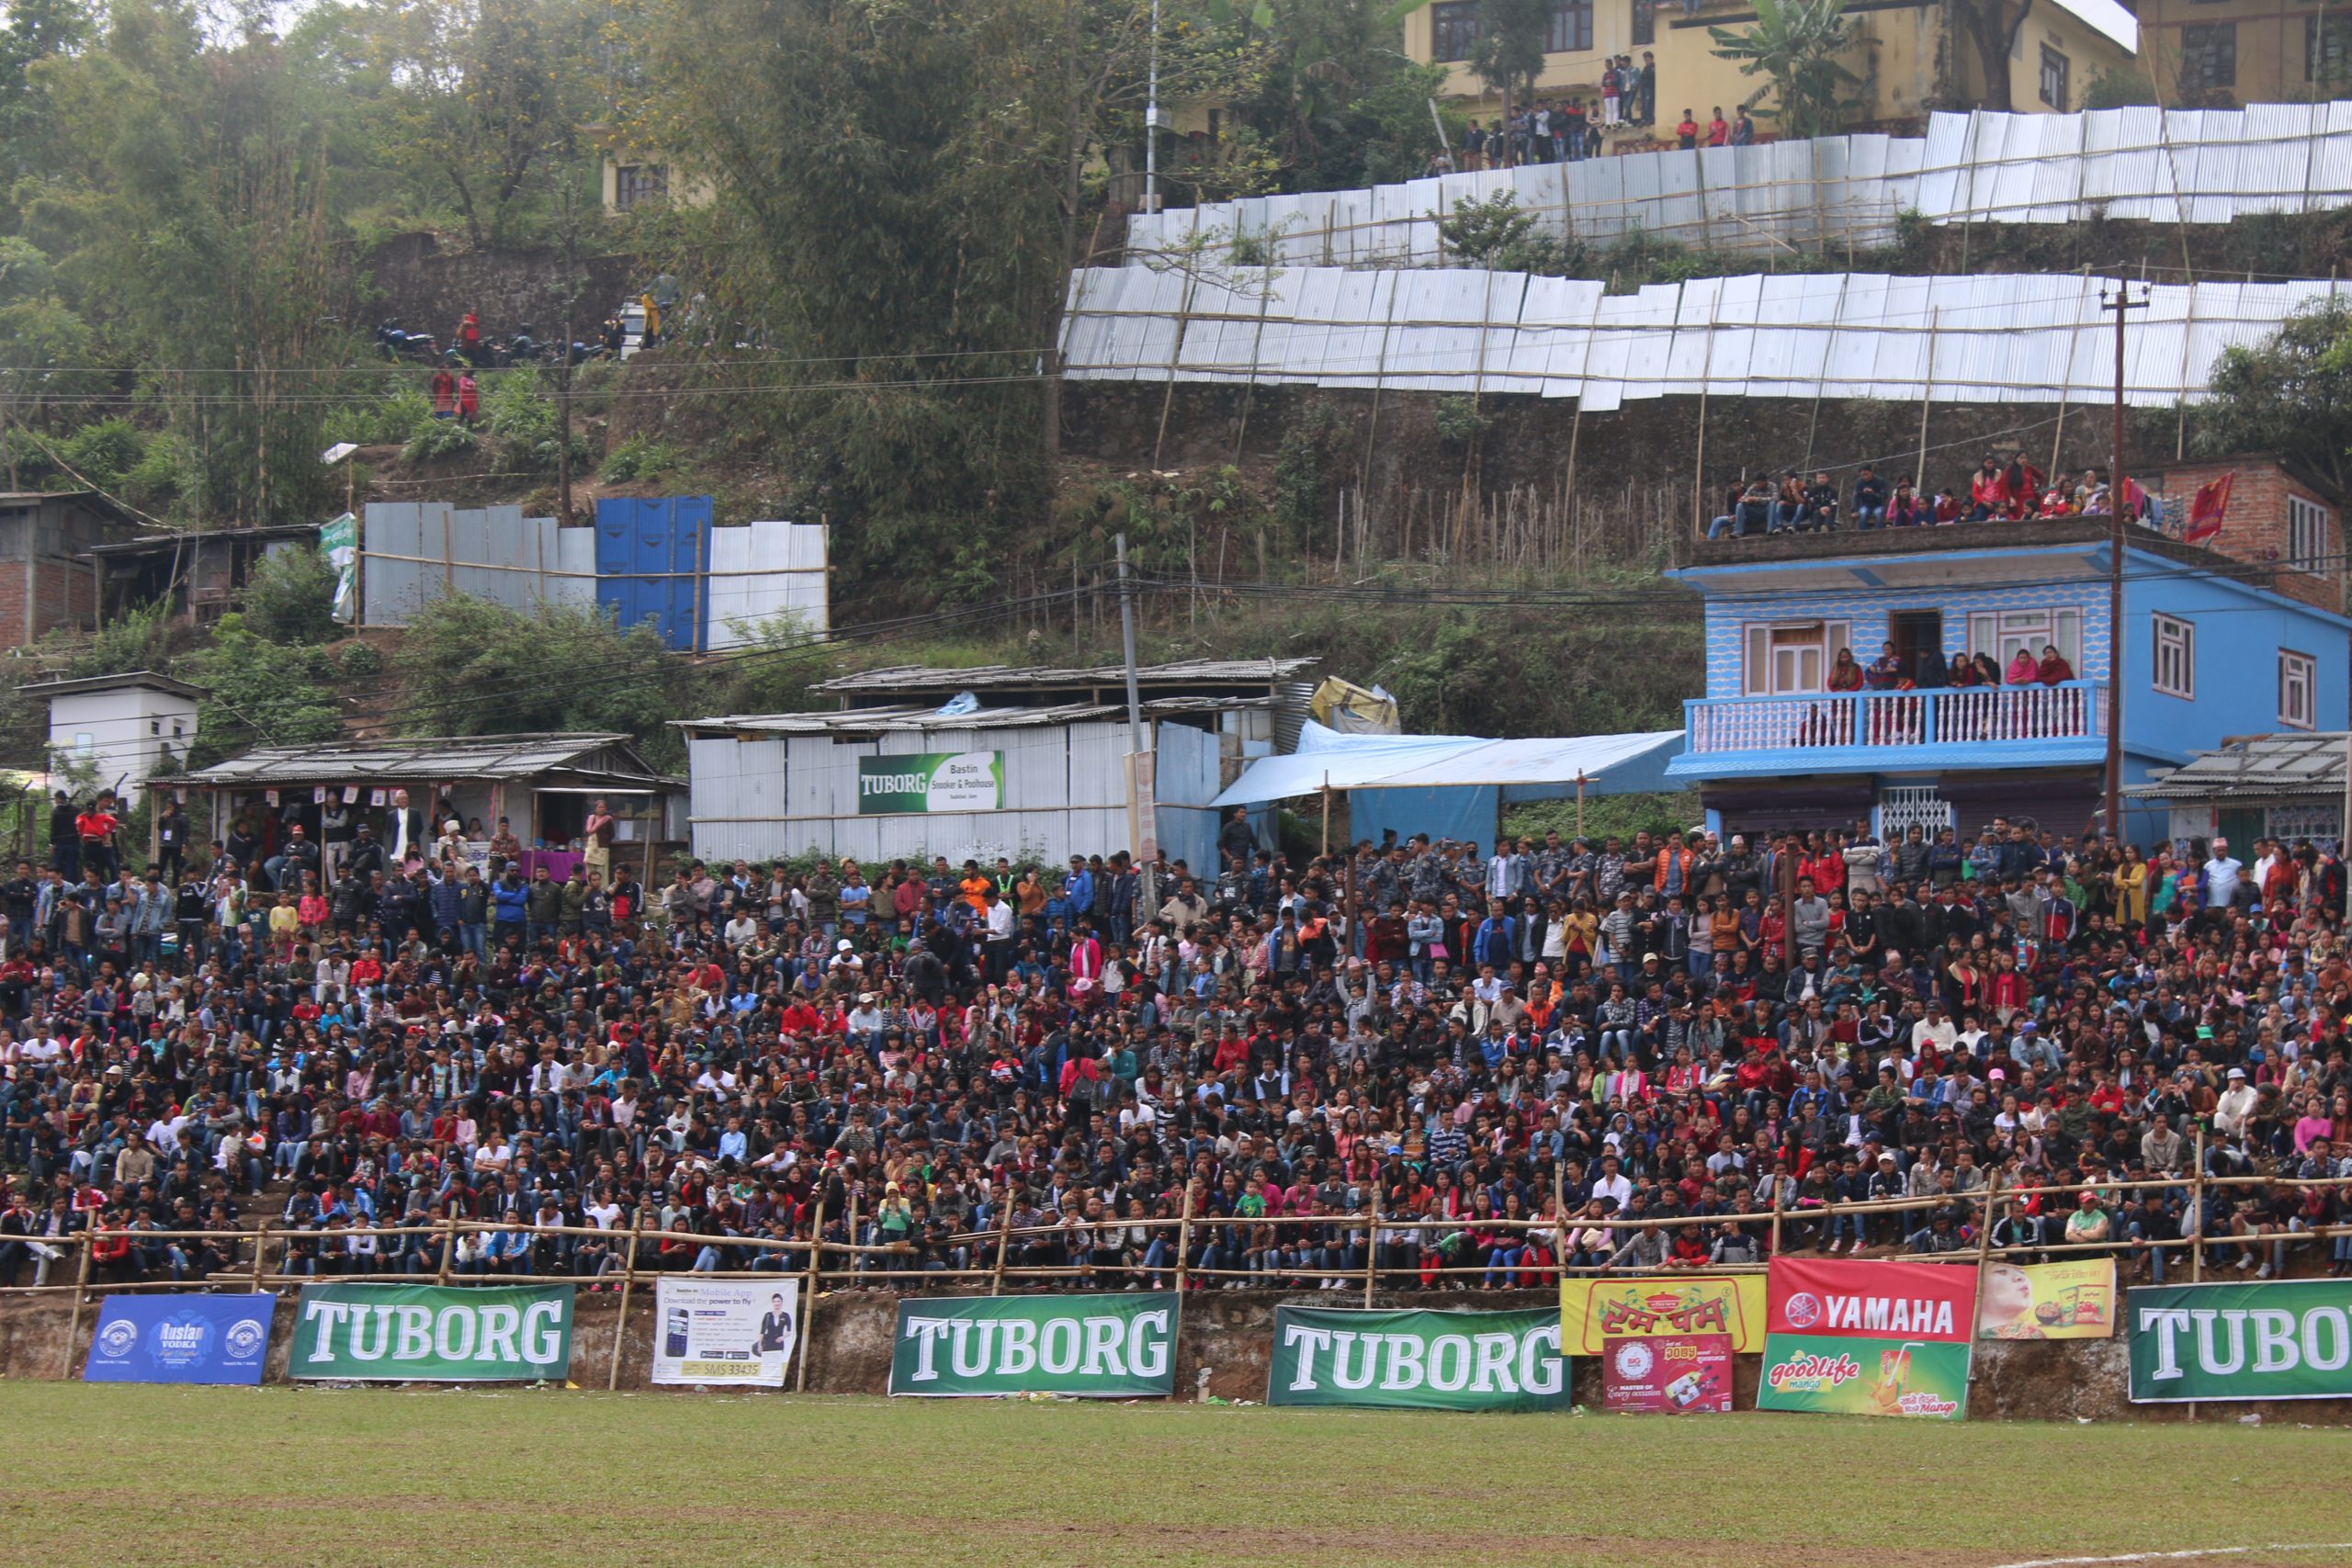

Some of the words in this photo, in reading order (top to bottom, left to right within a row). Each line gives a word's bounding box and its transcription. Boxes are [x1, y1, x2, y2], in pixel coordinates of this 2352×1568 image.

[950, 764, 978, 774] Bastin
[861, 773, 926, 795] TUBORG
[932, 780, 956, 790] Snooker
[957, 779, 964, 789] &
[965, 778, 995, 788] Poolhouse
[701, 1288, 731, 1296] Mobile
[734, 1289, 752, 1298] App
[1825, 1295, 1953, 1334] YAMAHA
[160, 1322, 204, 1340] Ruslan
[306, 1300, 563, 1364] TUBORG
[161, 1340, 198, 1348] VODKA
[906, 1309, 1168, 1382] TUBORG
[2140, 1305, 2352, 1381] TUBO
[1284, 1324, 1562, 1394] TUBORG
[704, 1363, 727, 1375] SMS
[728, 1364, 759, 1375] 33435
[1770, 1353, 1859, 1386] goodlife
[1607, 1384, 1631, 1401] Every
[1789, 1379, 1821, 1390] mango
[1919, 1401, 1956, 1416] Mango
